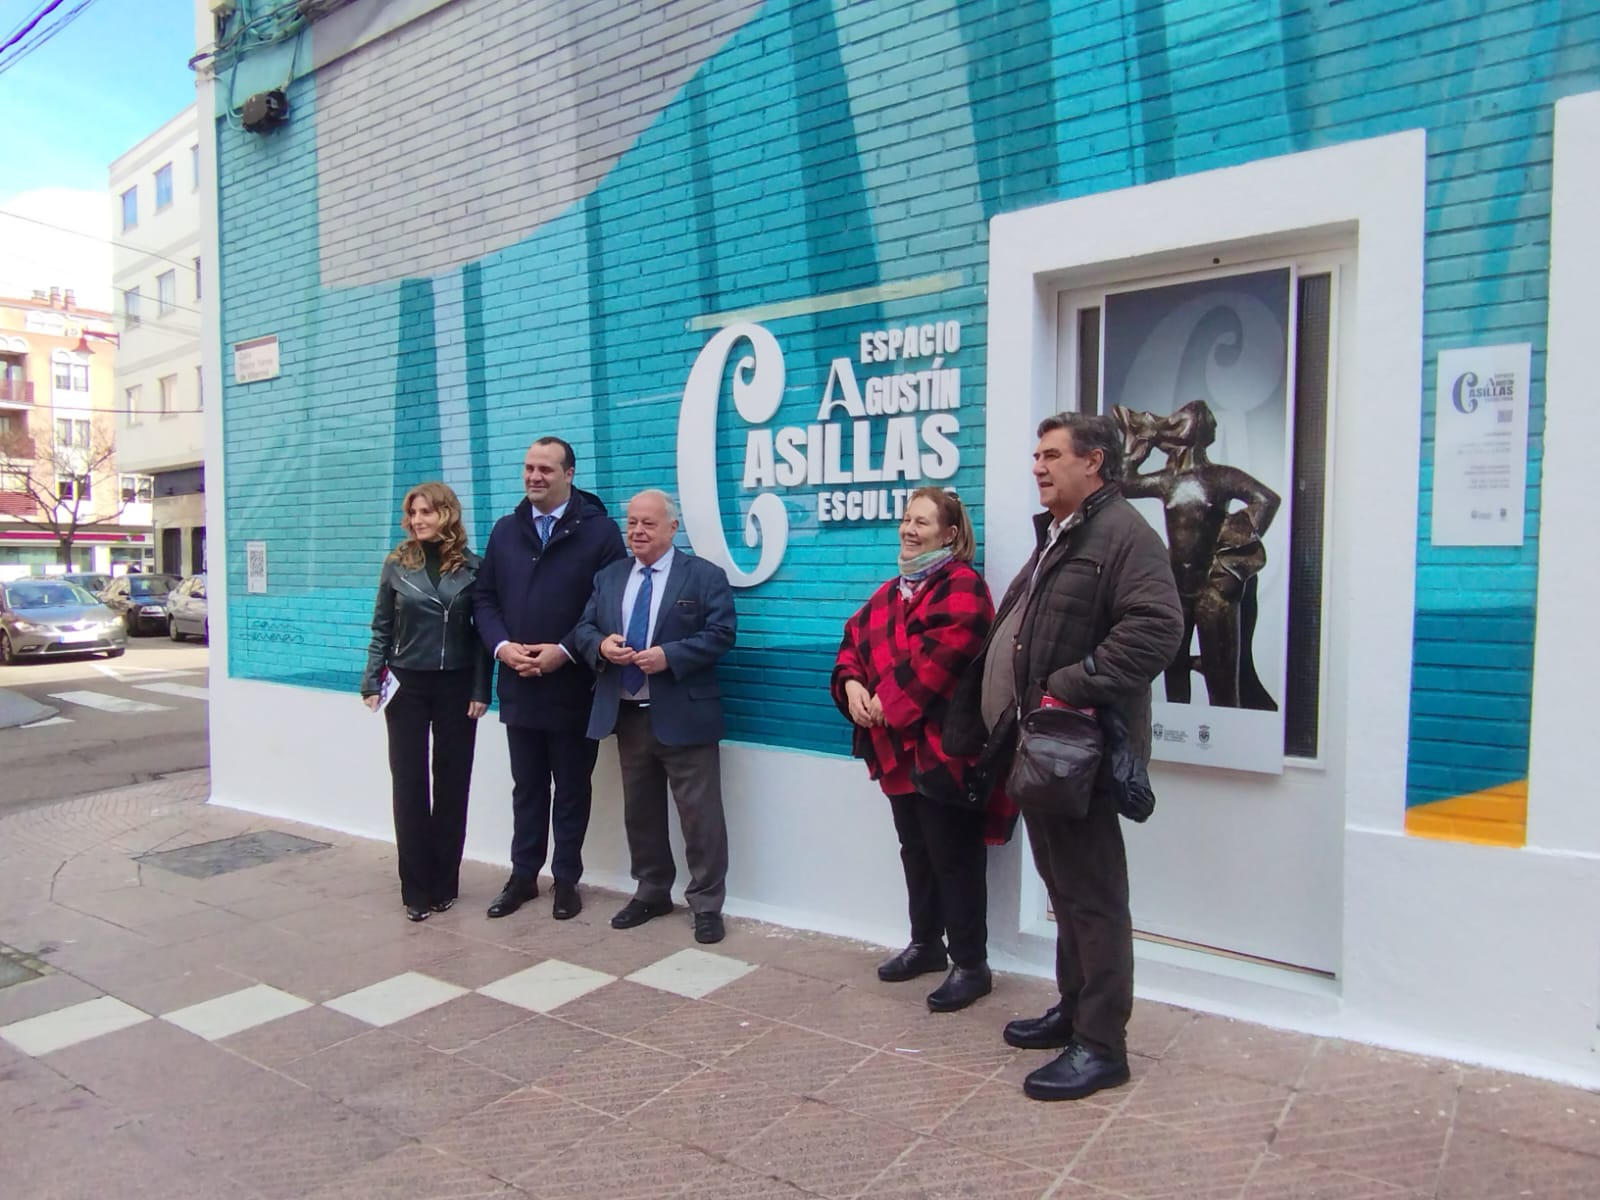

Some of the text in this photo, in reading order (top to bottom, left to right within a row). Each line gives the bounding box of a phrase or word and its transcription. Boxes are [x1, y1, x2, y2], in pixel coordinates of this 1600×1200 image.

[860, 320, 961, 364] ESPACIO
[817, 357, 961, 420] AGUSTÍN
[677, 322, 961, 587] CASILLAS
[818, 486, 958, 522] ESCULT
